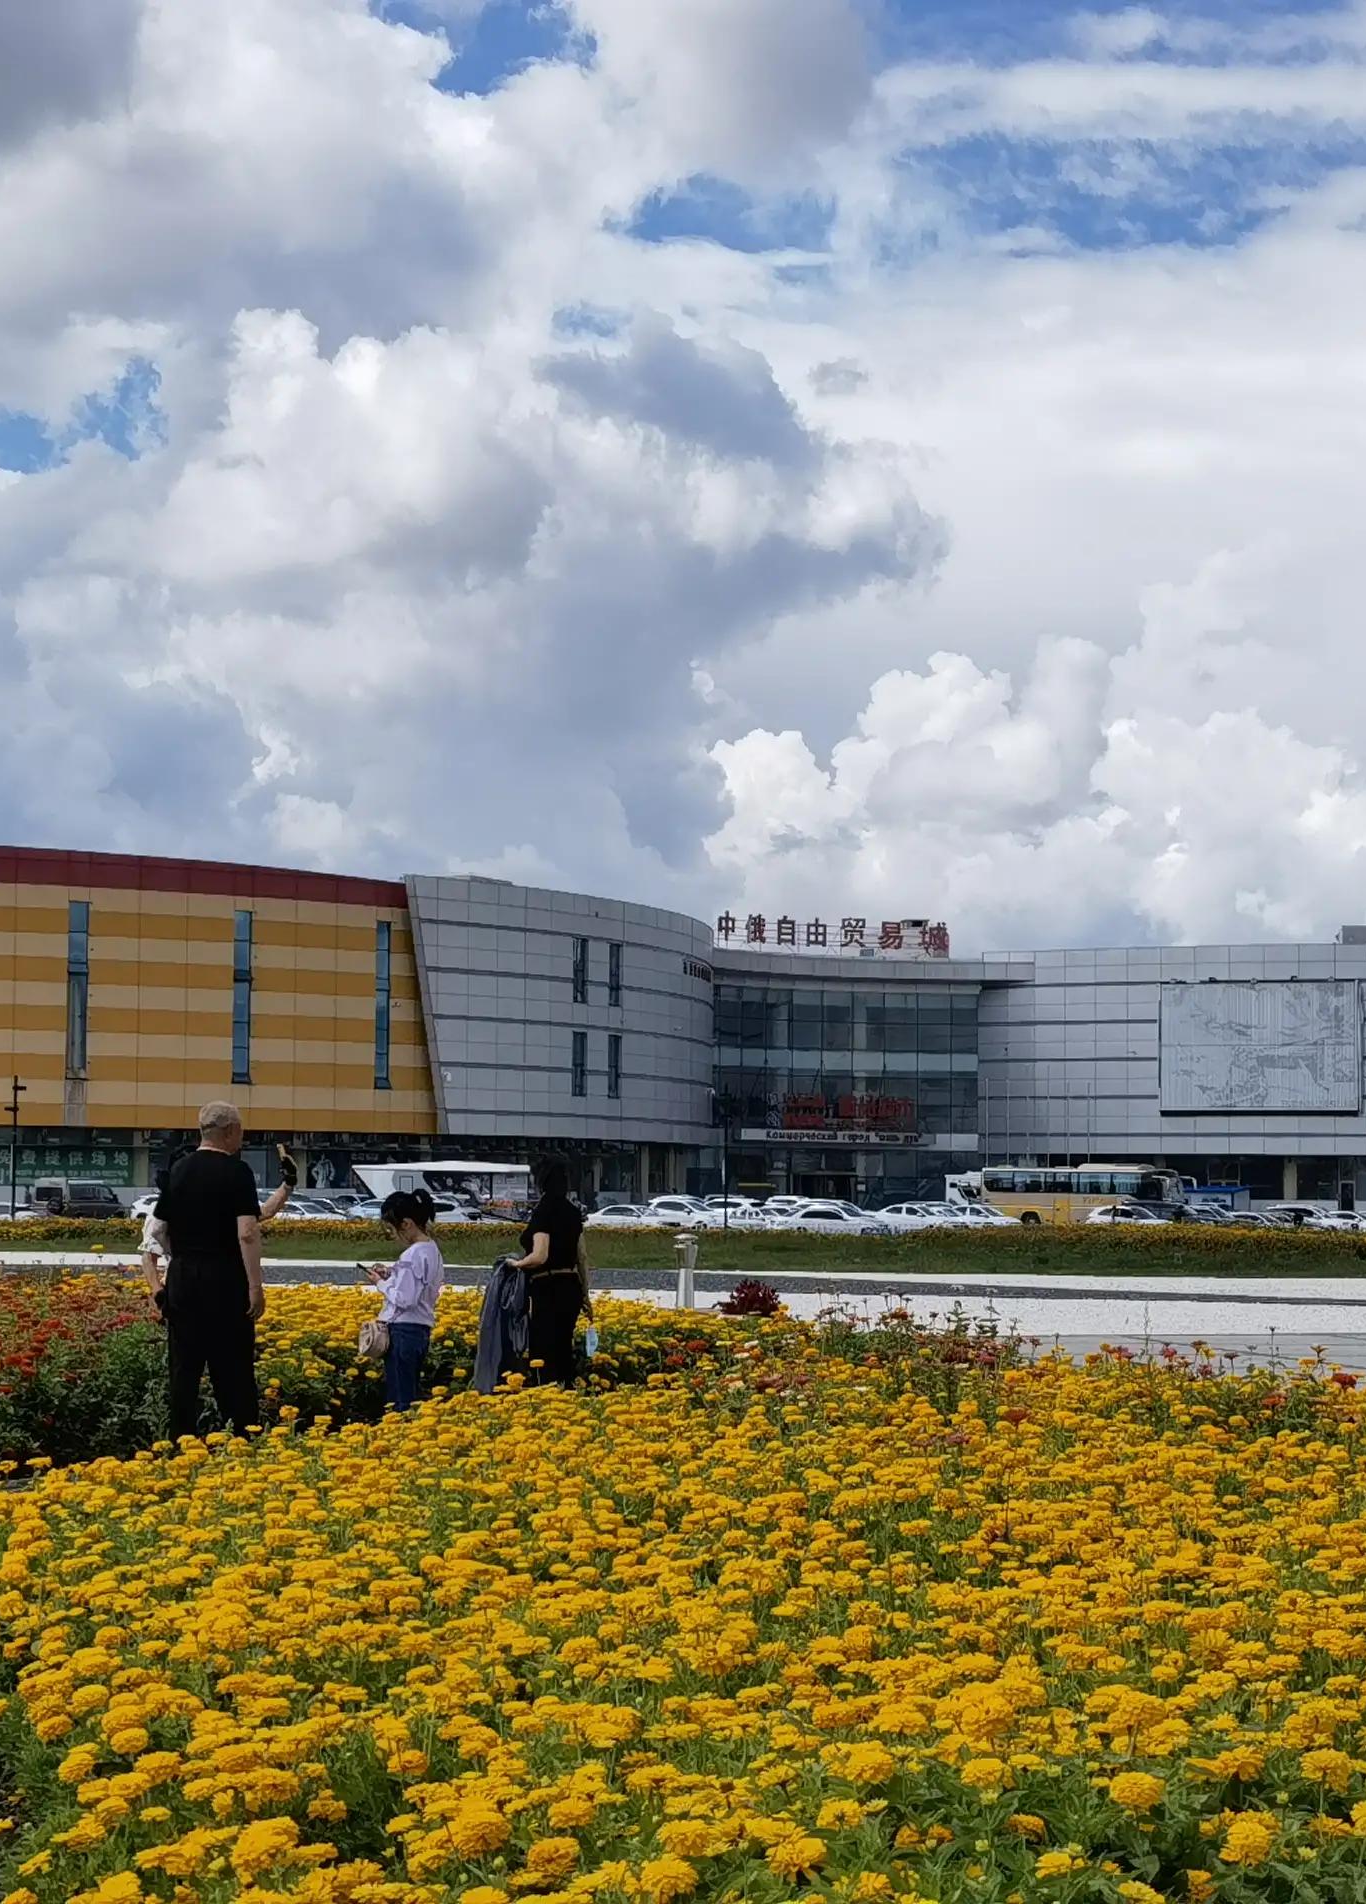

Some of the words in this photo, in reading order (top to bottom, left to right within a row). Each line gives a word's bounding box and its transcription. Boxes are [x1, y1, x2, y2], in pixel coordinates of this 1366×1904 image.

[718, 910, 950, 957] 中俄自由贸易城
